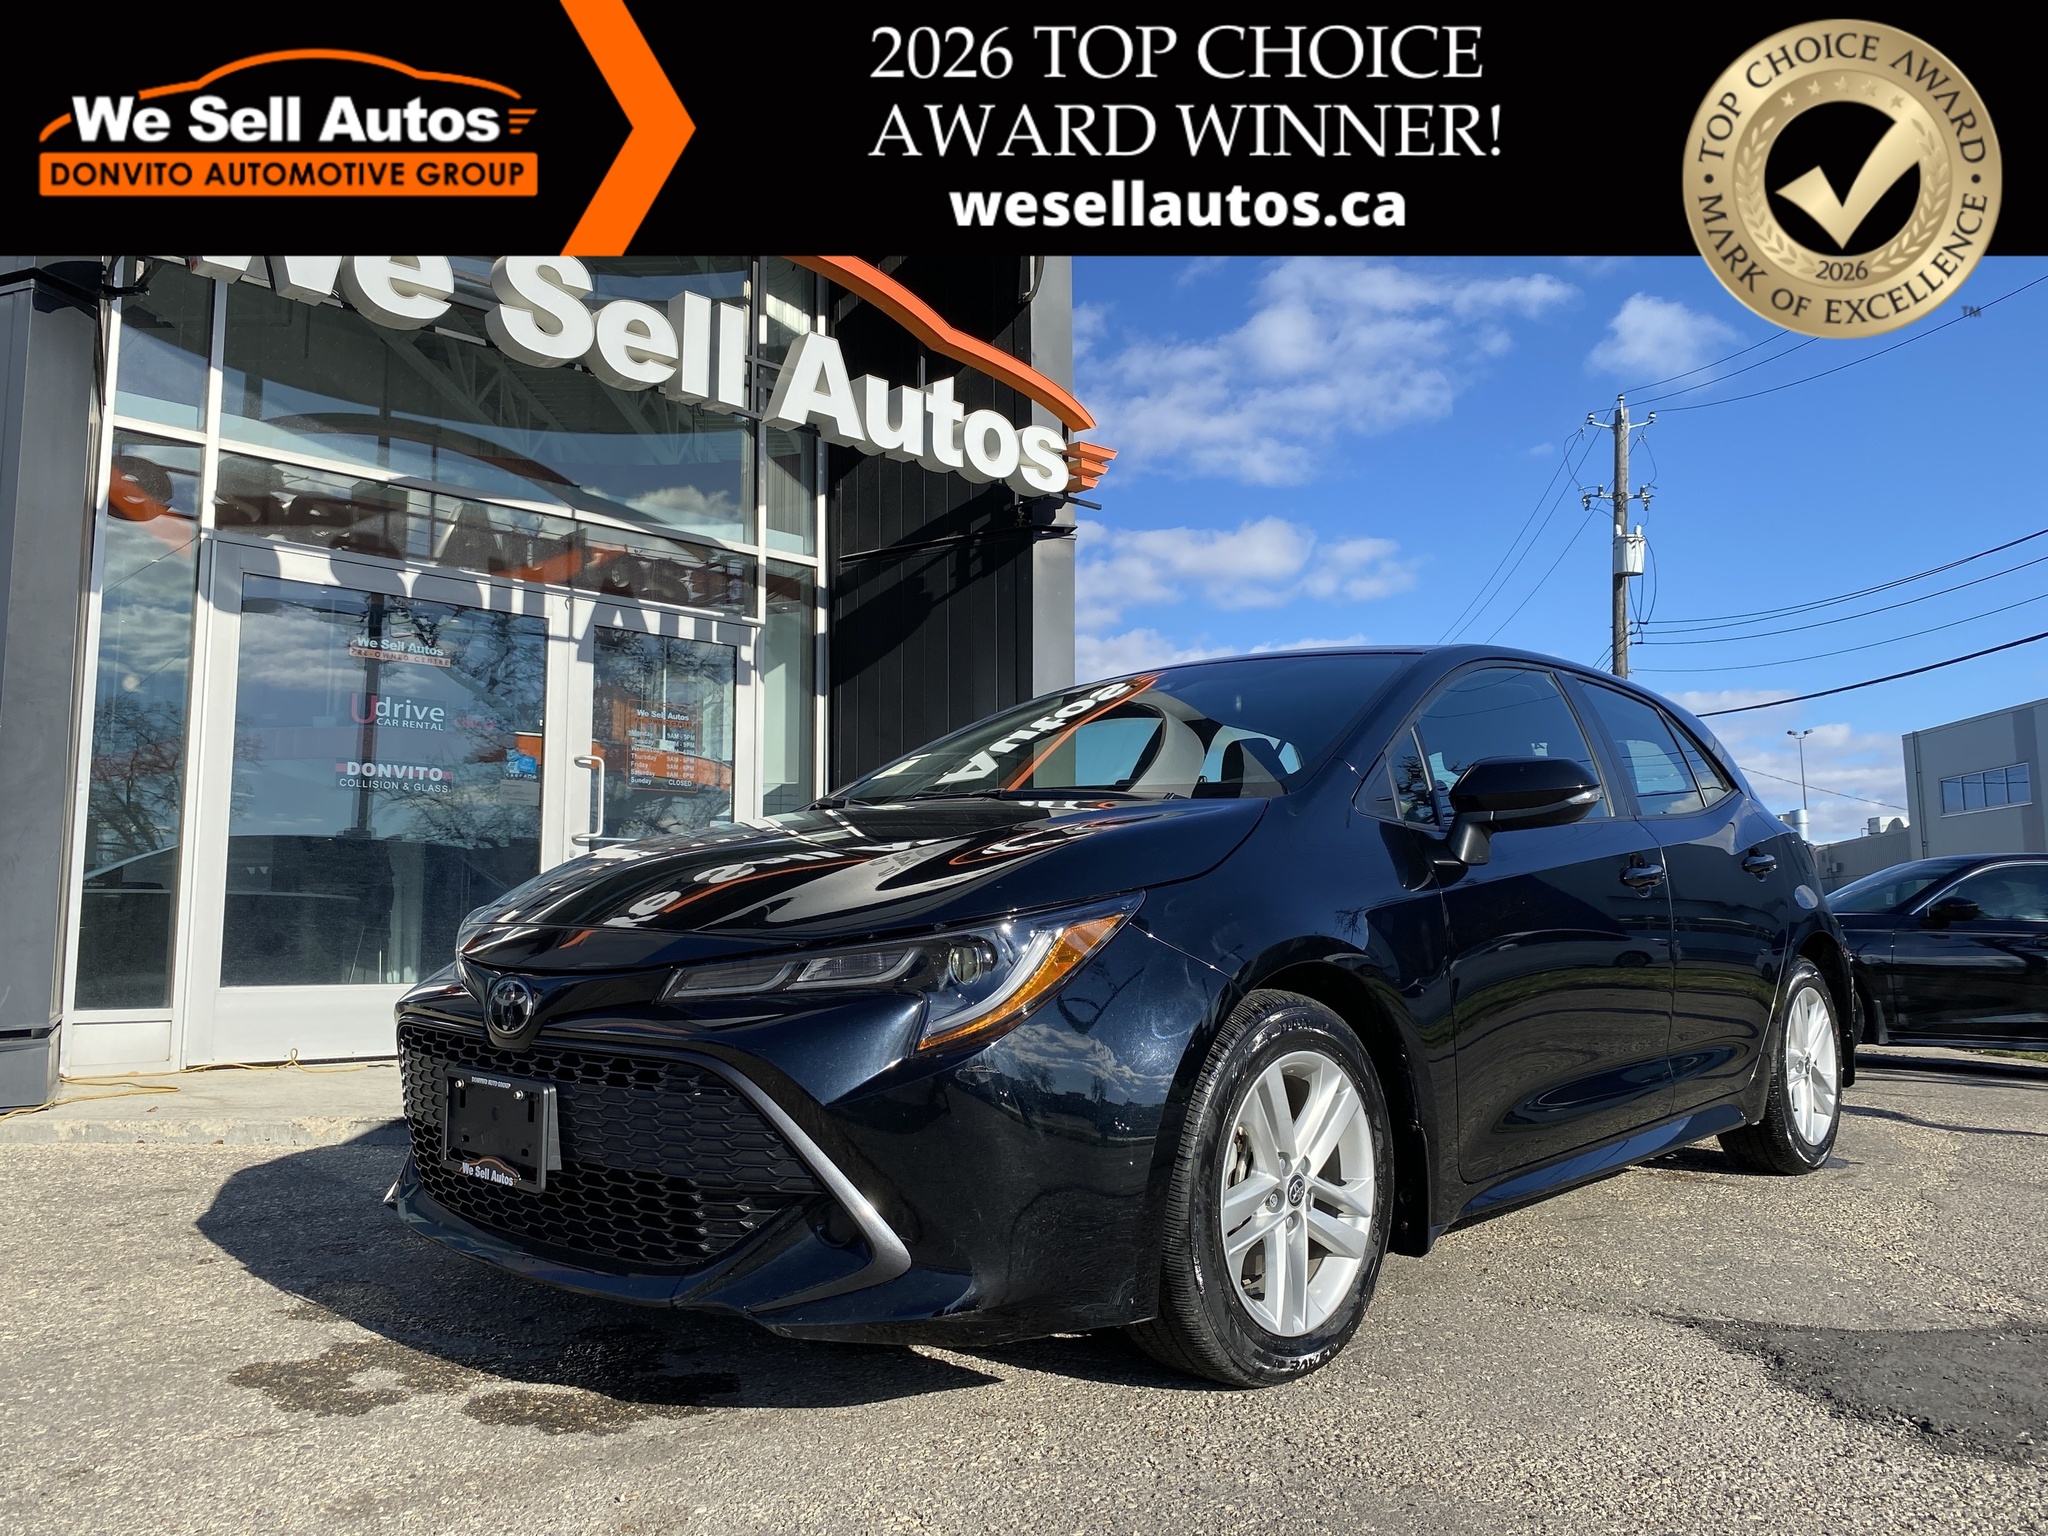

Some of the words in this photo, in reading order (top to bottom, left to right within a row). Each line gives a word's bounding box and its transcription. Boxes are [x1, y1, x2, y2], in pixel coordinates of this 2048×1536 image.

[485, 256, 745, 415] Sell
[762, 331, 1070, 497] Autos
[357, 636, 379, 648] We
[381, 639, 405, 652] Sell
[408, 643, 444, 656] Autos
[351, 693, 445, 724] Udrive
[667, 712, 690, 721] Autos
[376, 718, 399, 727] CAR
[402, 720, 444, 731] RENTAL
[631, 753, 657, 762] Thursday
[346, 761, 443, 782] DONVITO
[339, 778, 399, 790] COLLISION
[402, 783, 410, 791] &
[631, 777, 652, 785] Sunday
[668, 779, 692, 787] CLOSED
[462, 1162, 474, 1176] We
[475, 1165, 490, 1180] Sell
[491, 1170, 514, 1187] Autos
